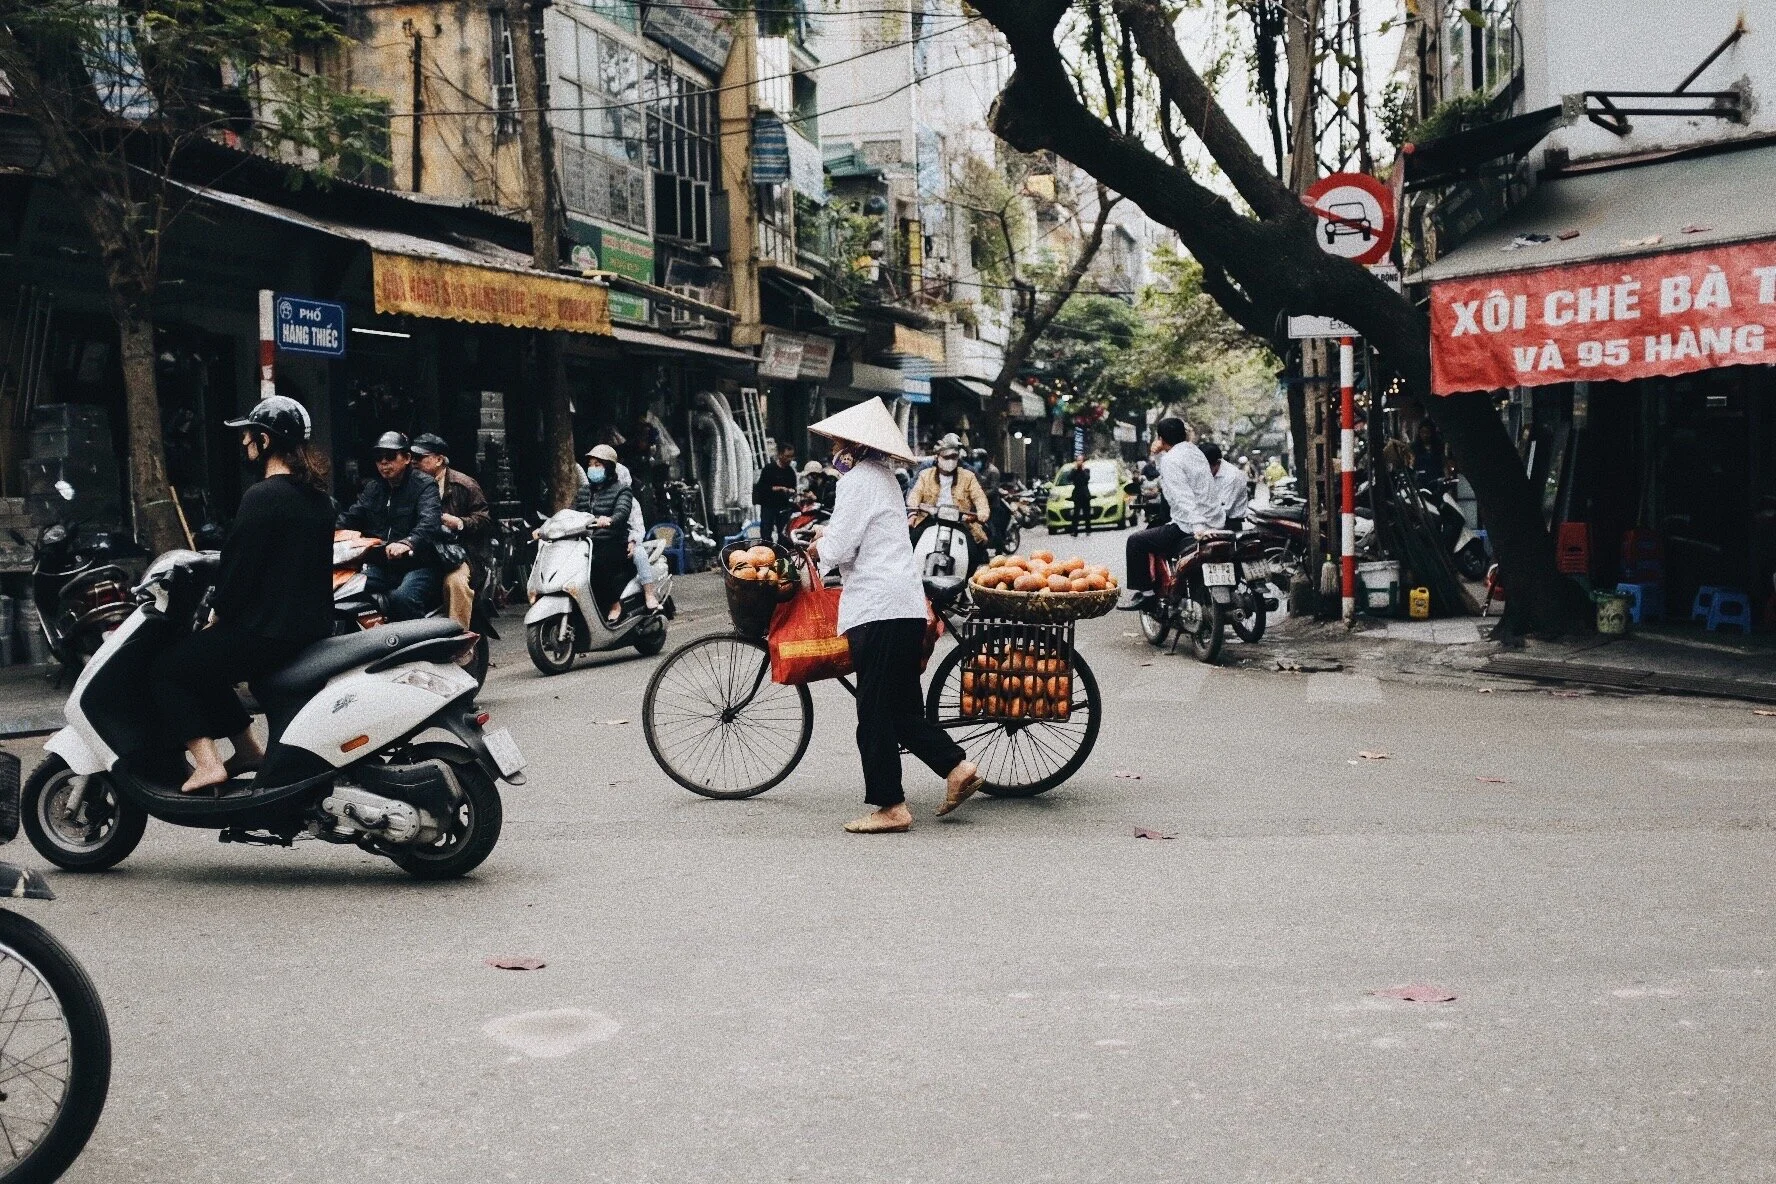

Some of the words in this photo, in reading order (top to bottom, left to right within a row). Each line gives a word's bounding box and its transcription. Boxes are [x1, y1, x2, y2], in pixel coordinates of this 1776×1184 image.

[300, 307, 321, 321] PHỐ
[1451, 289, 1527, 337] XÔI
[1544, 275, 1641, 327] CHÈ
[1660, 264, 1732, 315] BÀ
[283, 320, 309, 345] HÀNG
[312, 323, 338, 348] THIẾC
[1513, 339, 1564, 372] VÀ
[1577, 339, 1630, 367] 95
[1645, 325, 1764, 362] HÀNG
